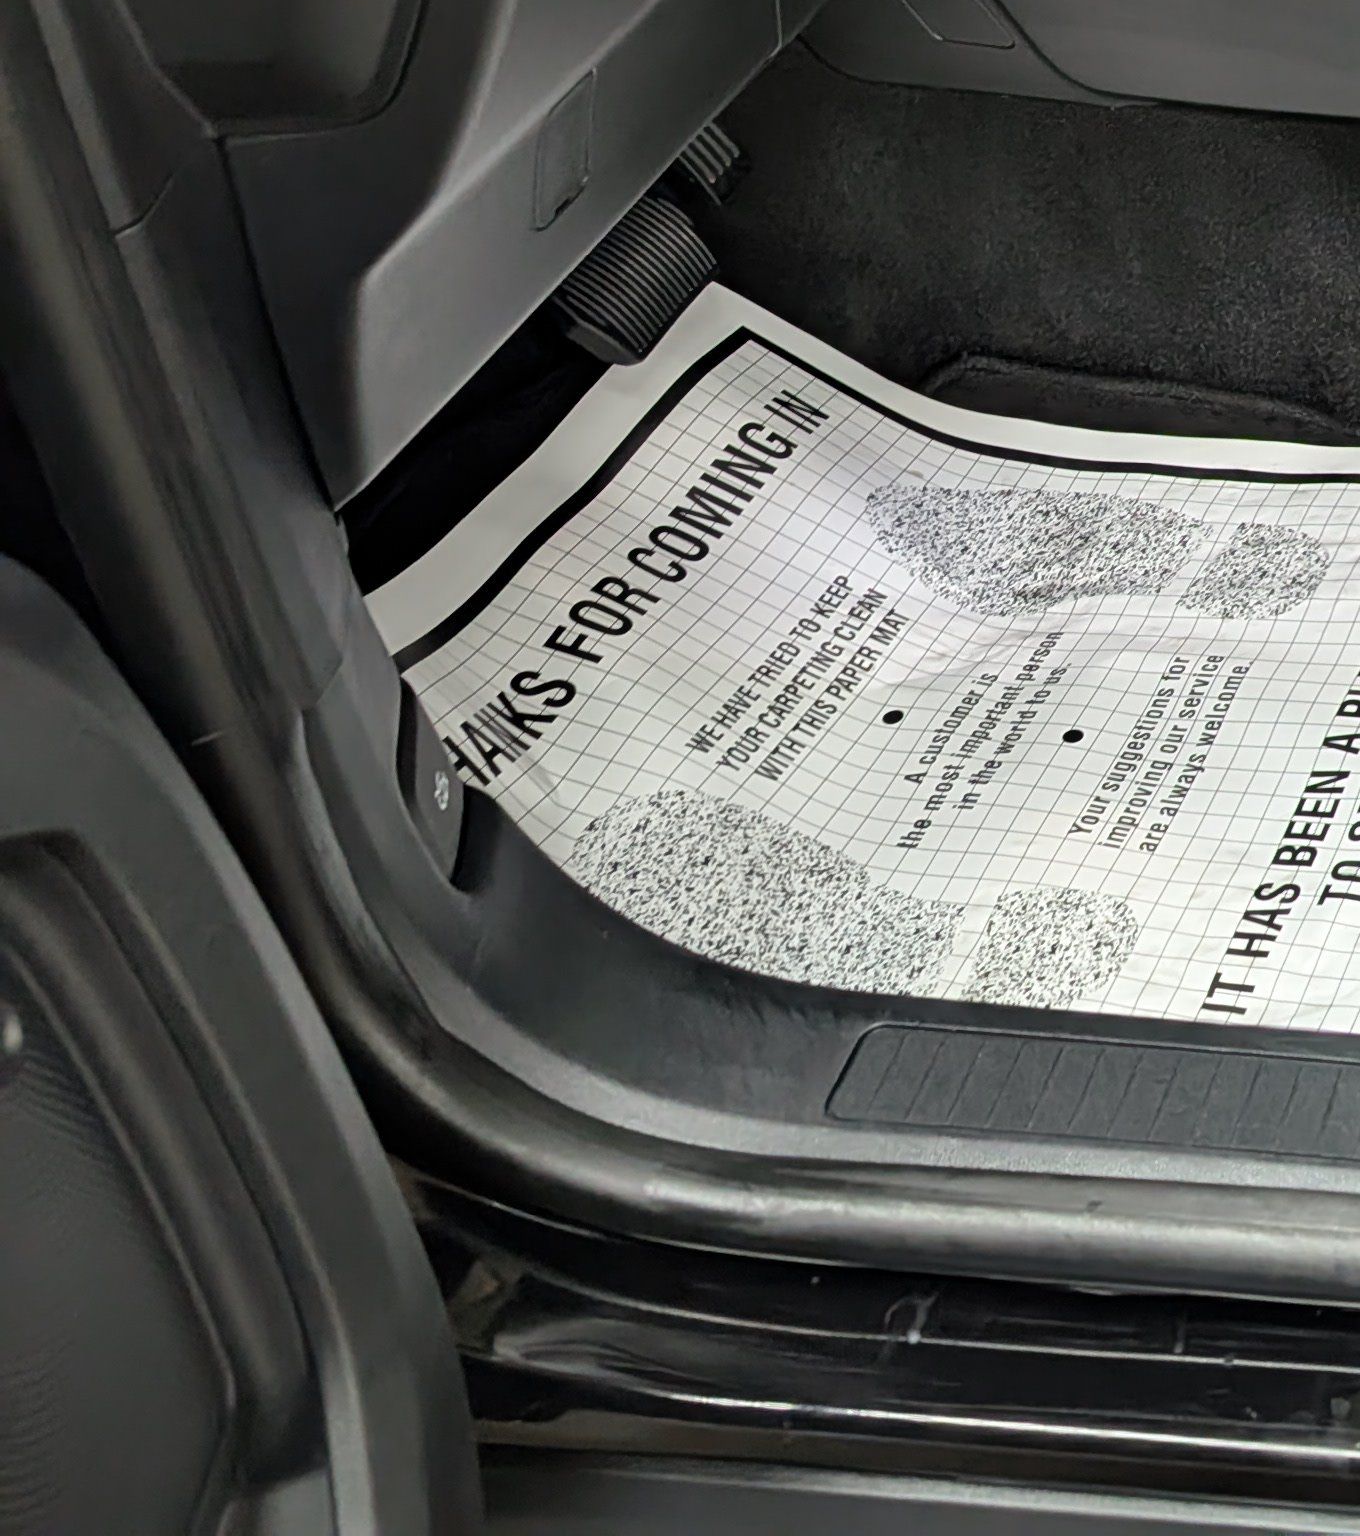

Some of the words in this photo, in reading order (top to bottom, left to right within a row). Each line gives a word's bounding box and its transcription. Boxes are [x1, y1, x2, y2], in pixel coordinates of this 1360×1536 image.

[443, 670, 576, 786] HANKS
[543, 576, 660, 664] FOR
[628, 422, 799, 583] COMING
[764, 389, 830, 435] IN
[685, 724, 724, 754] WE
[712, 686, 761, 730] HAVE
[748, 641, 800, 687] TRIED
[789, 618, 821, 641] TO
[810, 575, 853, 619] KEEP
[716, 726, 770, 771] YOUR
[758, 641, 844, 729] CARPETING
[834, 588, 888, 641] CLEAN
[754, 740, 806, 782] WITH
[793, 699, 838, 737] THIS
[826, 646, 882, 701] PAPER
[870, 608, 910, 646] MAT
[897, 818, 932, 848] the
[924, 764, 965, 811] most
[950, 686, 1024, 759] important
[1016, 632, 1064, 681] person
[904, 772, 927, 784] A
[920, 690, 984, 764] customer
[972, 673, 999, 687] is
[953, 792, 981, 810] in
[968, 760, 1002, 785] the
[994, 711, 1038, 754] world
[1026, 690, 1051, 705] to
[1043, 663, 1072, 686] us.
[1068, 796, 1111, 835] Your
[1102, 688, 1174, 792] suggestions
[1162, 657, 1190, 681] for
[1098, 760, 1172, 849] improving
[1160, 725, 1188, 754] our
[1179, 655, 1225, 718] service
[1139, 823, 1169, 852] are
[1160, 754, 1206, 816] always
[1196, 662, 1253, 746] welcome.
[1272, 770, 1350, 867] BEEN
[1202, 972, 1255, 1015] IT
[1227, 883, 1300, 957] HAS
